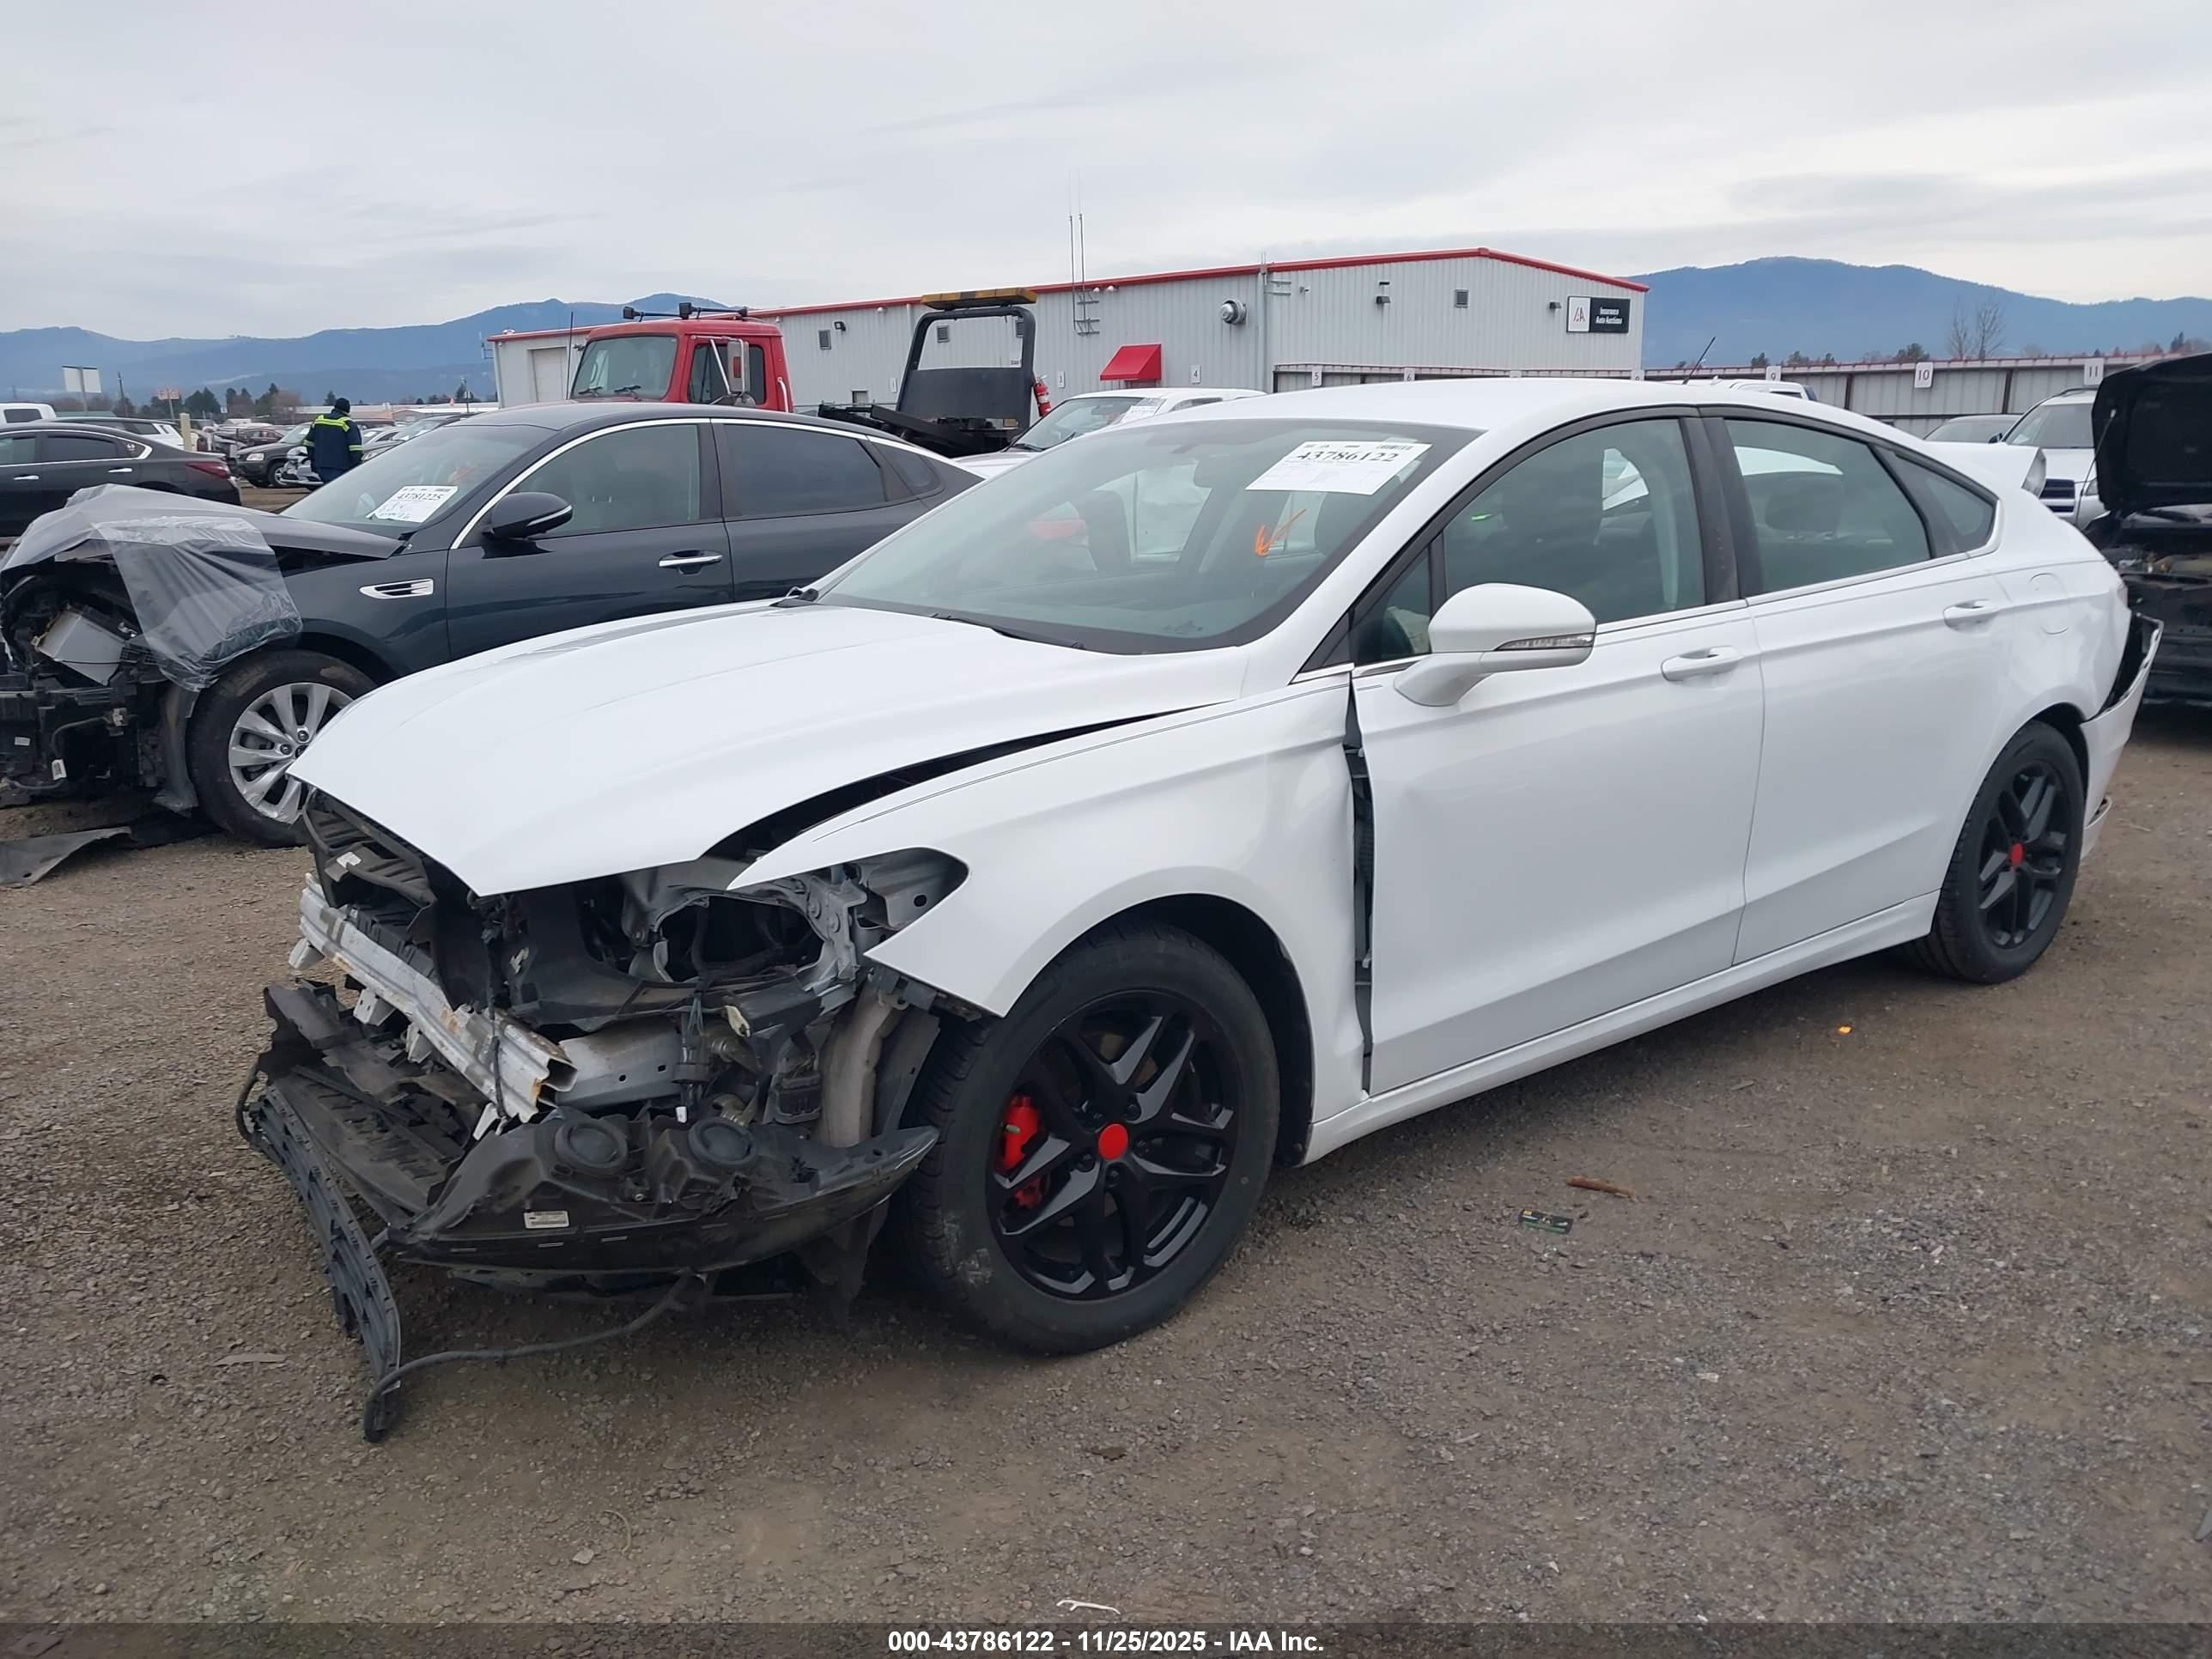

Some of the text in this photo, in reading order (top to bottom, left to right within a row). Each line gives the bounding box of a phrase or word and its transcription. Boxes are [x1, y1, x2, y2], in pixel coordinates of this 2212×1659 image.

[1595, 316, 1606, 325] Auto
[1315, 371, 1320, 380] 5
[1407, 372, 1412, 382] 6
[1917, 369, 1930, 380] 10
[2089, 366, 2099, 378] 11
[1297, 451, 1400, 462] 43786122
